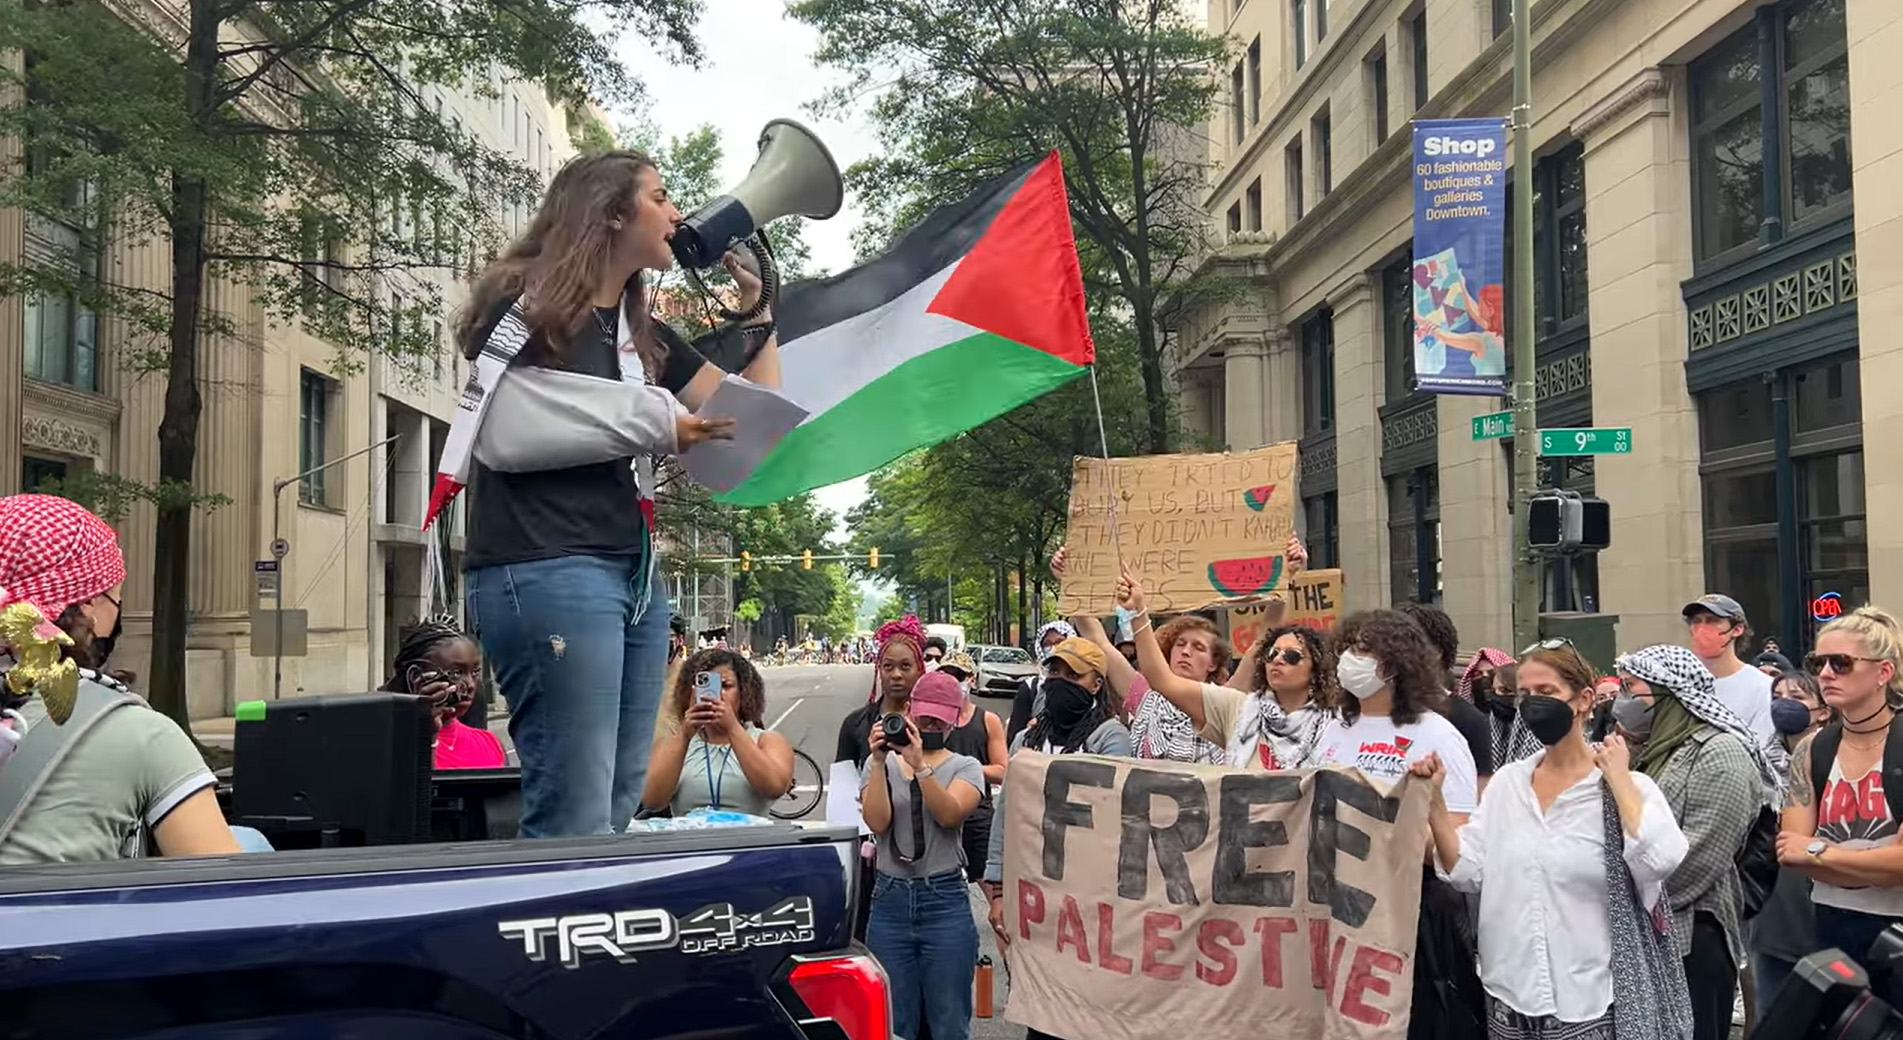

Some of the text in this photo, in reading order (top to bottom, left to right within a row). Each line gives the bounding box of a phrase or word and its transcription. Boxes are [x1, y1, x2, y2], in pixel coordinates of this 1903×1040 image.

[1424, 137, 1495, 157] Shop
[1417, 160, 1502, 176] 60 fashionable
[1424, 173, 1494, 191] boutiques &
[1434, 190, 1483, 207] galleries
[1426, 206, 1491, 220] Downtown.
[1474, 423, 1479, 434] E
[1483, 415, 1504, 437] Main
[1544, 431, 1626, 452] S 9th St
[1614, 442, 1628, 452] 00
[1147, 491, 1183, 515] US,
[1194, 487, 1241, 515] BUT
[1066, 550, 1112, 577] WE
[1061, 578, 1176, 614] SEDS
[1288, 579, 1334, 611] THE
[1042, 759, 1400, 928] FREE
[498, 908, 676, 967] TRD
[681, 928, 815, 953] OFF ROAD
